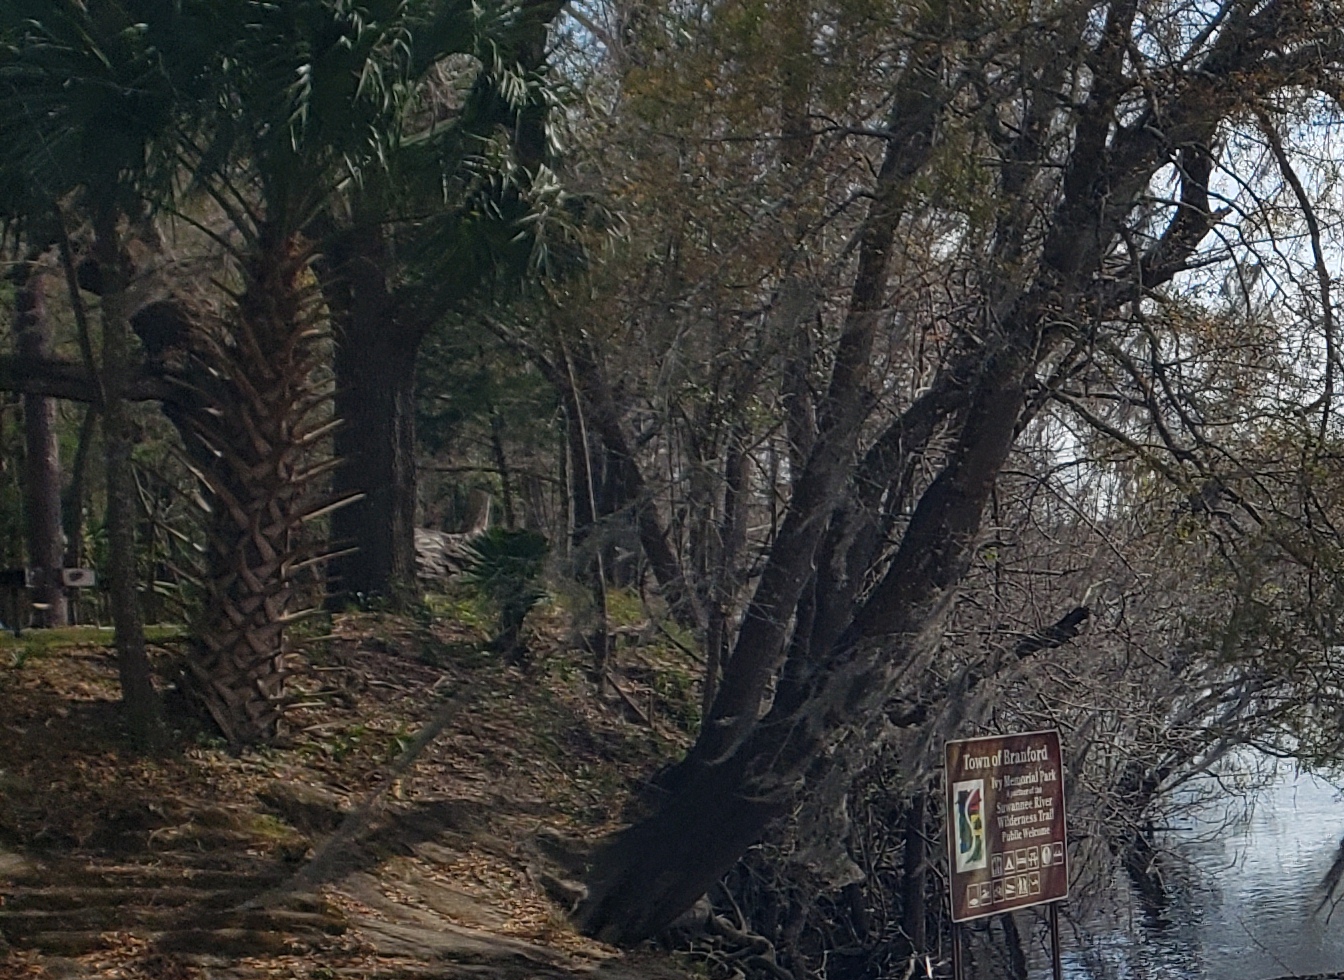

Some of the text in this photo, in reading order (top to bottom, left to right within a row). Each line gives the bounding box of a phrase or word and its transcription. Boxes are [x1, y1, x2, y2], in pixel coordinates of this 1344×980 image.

[963, 745, 1048, 770] Town of Branford
[991, 769, 1056, 791] Ivy Memorial Park
[996, 796, 1052, 814] Suwannee River
[997, 808, 1054, 828] Wilderness Trail
[1002, 826, 1050, 842] Public Welcome
